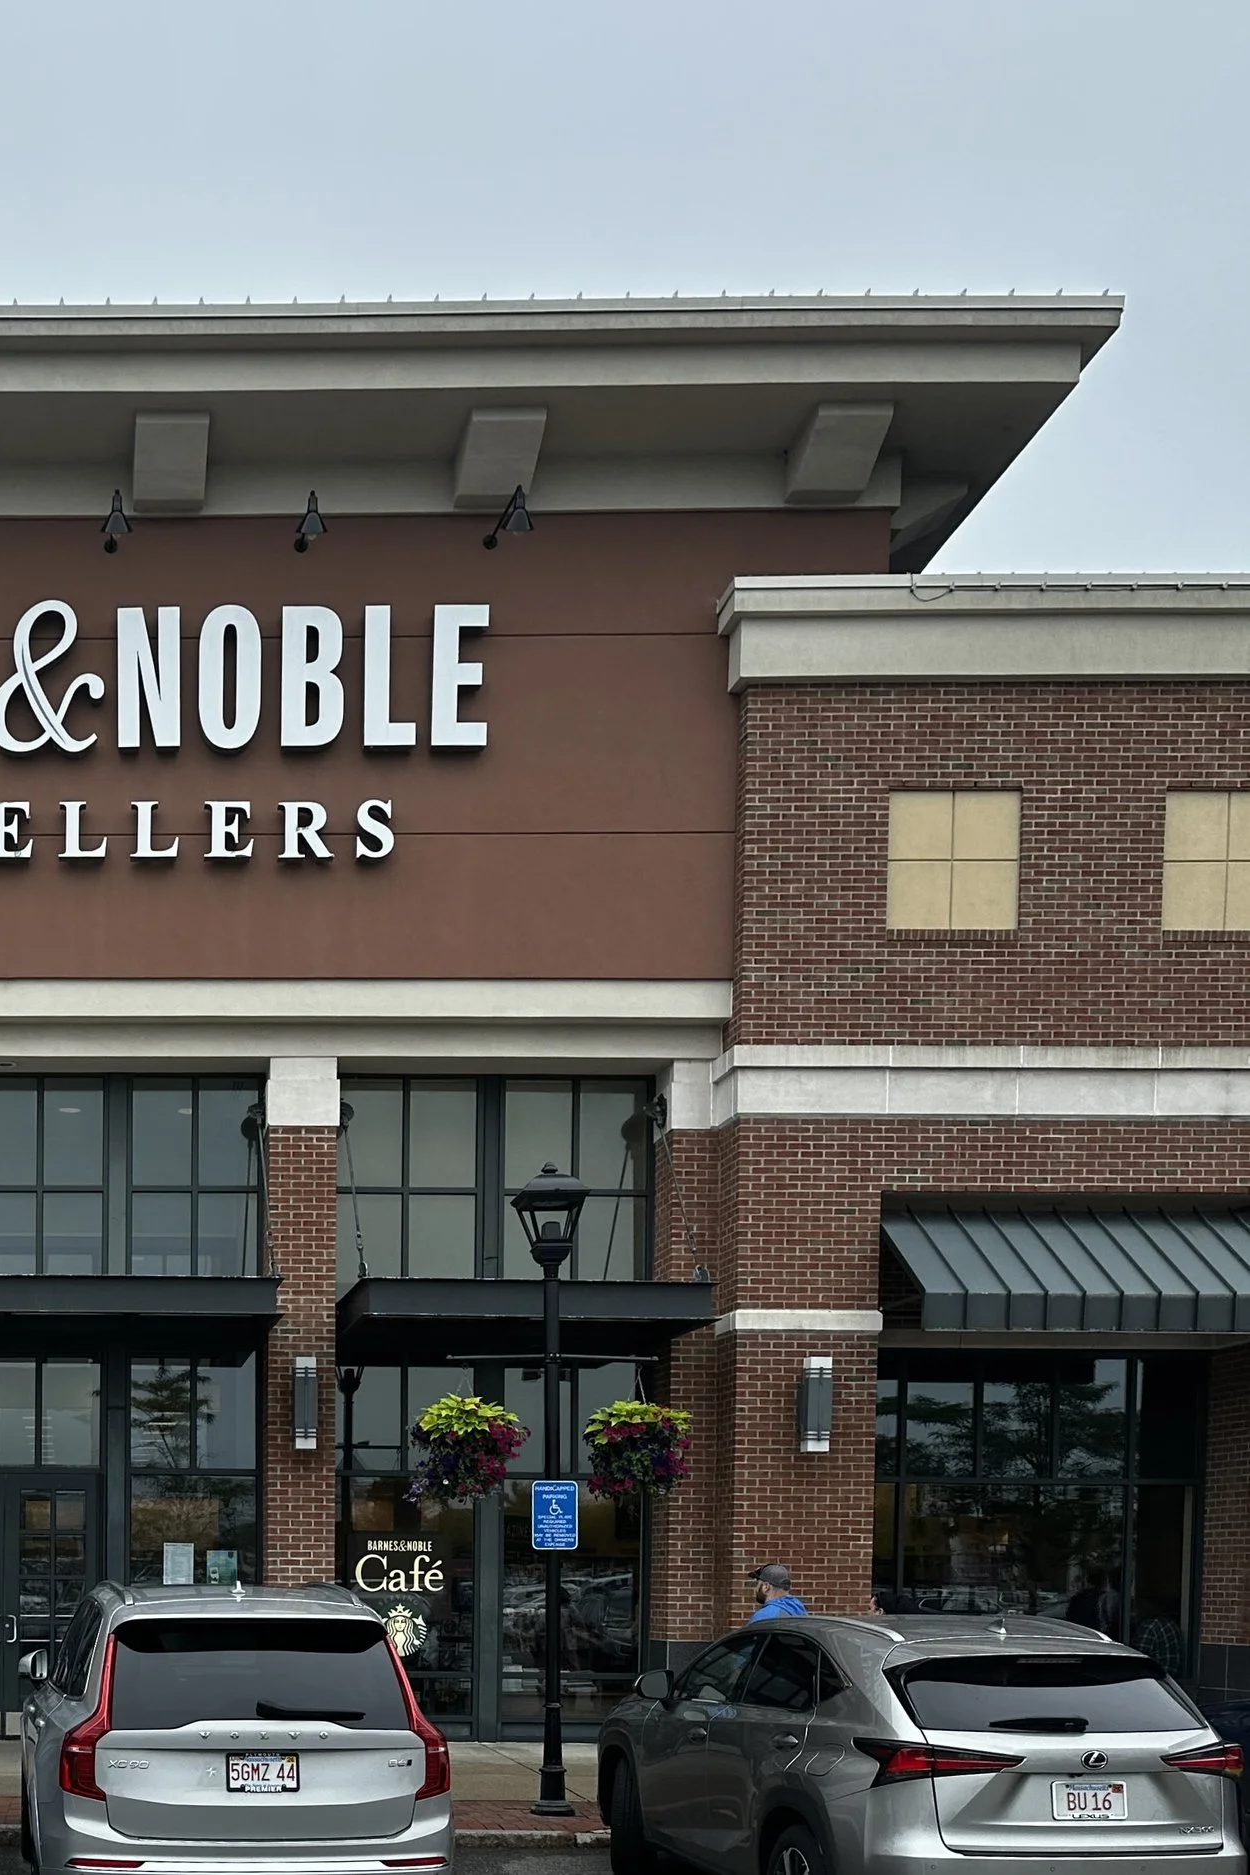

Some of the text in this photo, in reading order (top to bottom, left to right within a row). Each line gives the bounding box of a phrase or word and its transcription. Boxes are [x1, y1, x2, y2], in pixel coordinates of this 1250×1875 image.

[355, 1553, 444, 1592] Café
[198, 1731, 328, 1740] VOLVO
[231, 1763, 296, 1782] 5GMZ 44
[244, 1785, 283, 1793] PREMIER
[1066, 1792, 1112, 1811] BU 16
